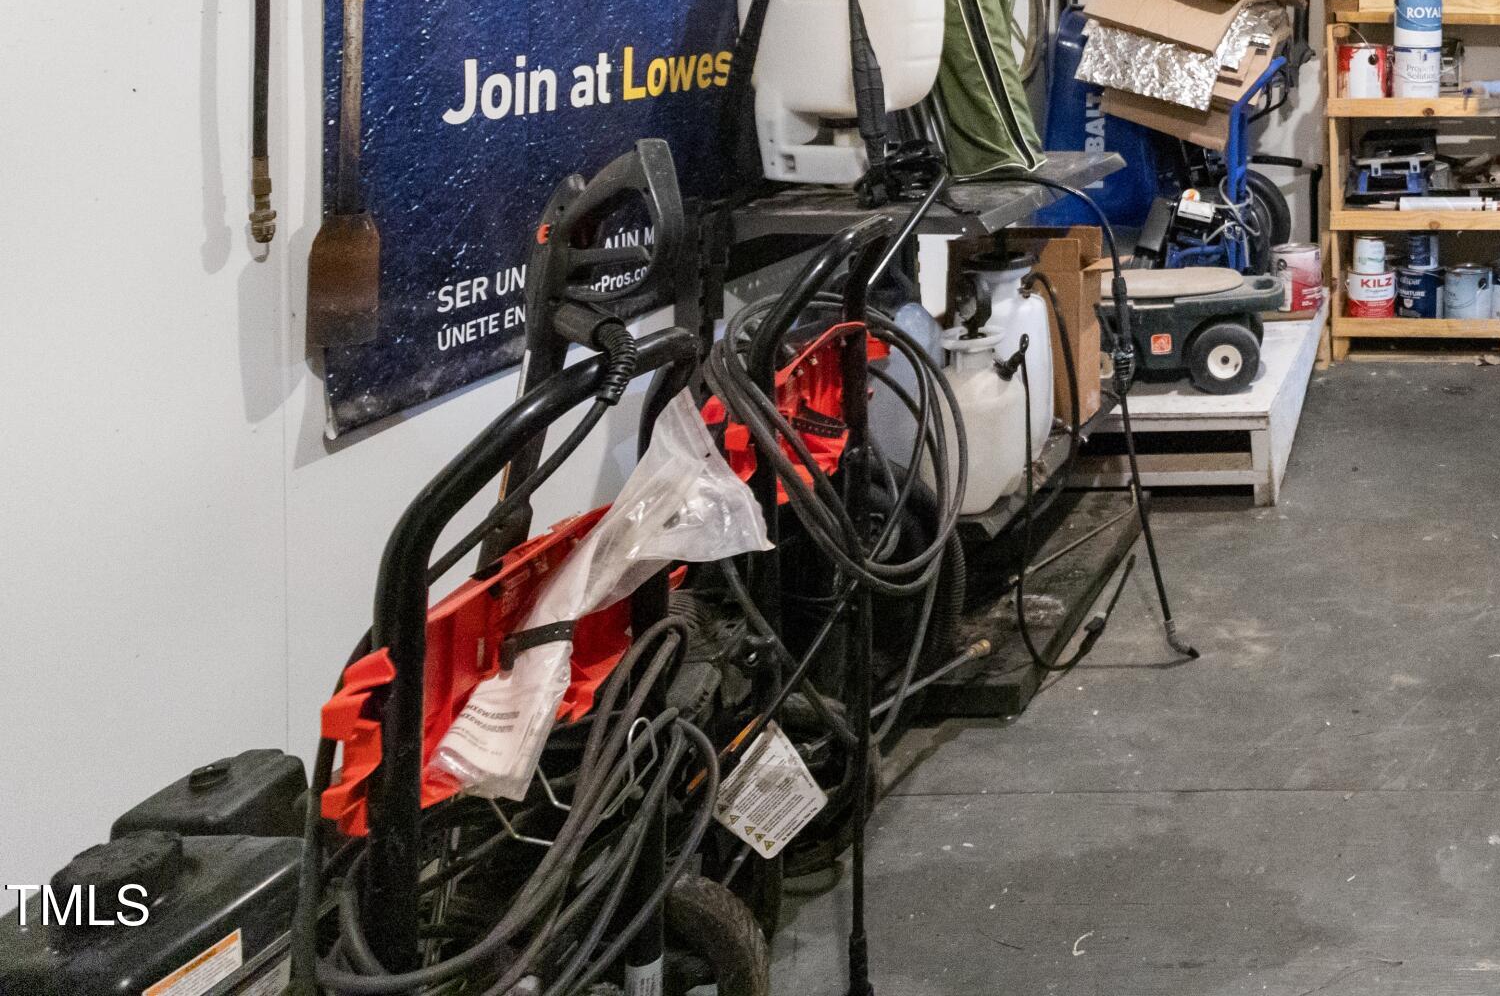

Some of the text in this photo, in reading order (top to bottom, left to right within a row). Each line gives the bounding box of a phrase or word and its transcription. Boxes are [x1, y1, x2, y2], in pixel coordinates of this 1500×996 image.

[442, 46, 734, 126] Join at Lowes
[437, 276, 487, 313] SER
[496, 264, 526, 295] UN
[1361, 277, 1392, 288] KILZ
[437, 313, 499, 352] ÚNETE
[504, 305, 526, 329] EN
